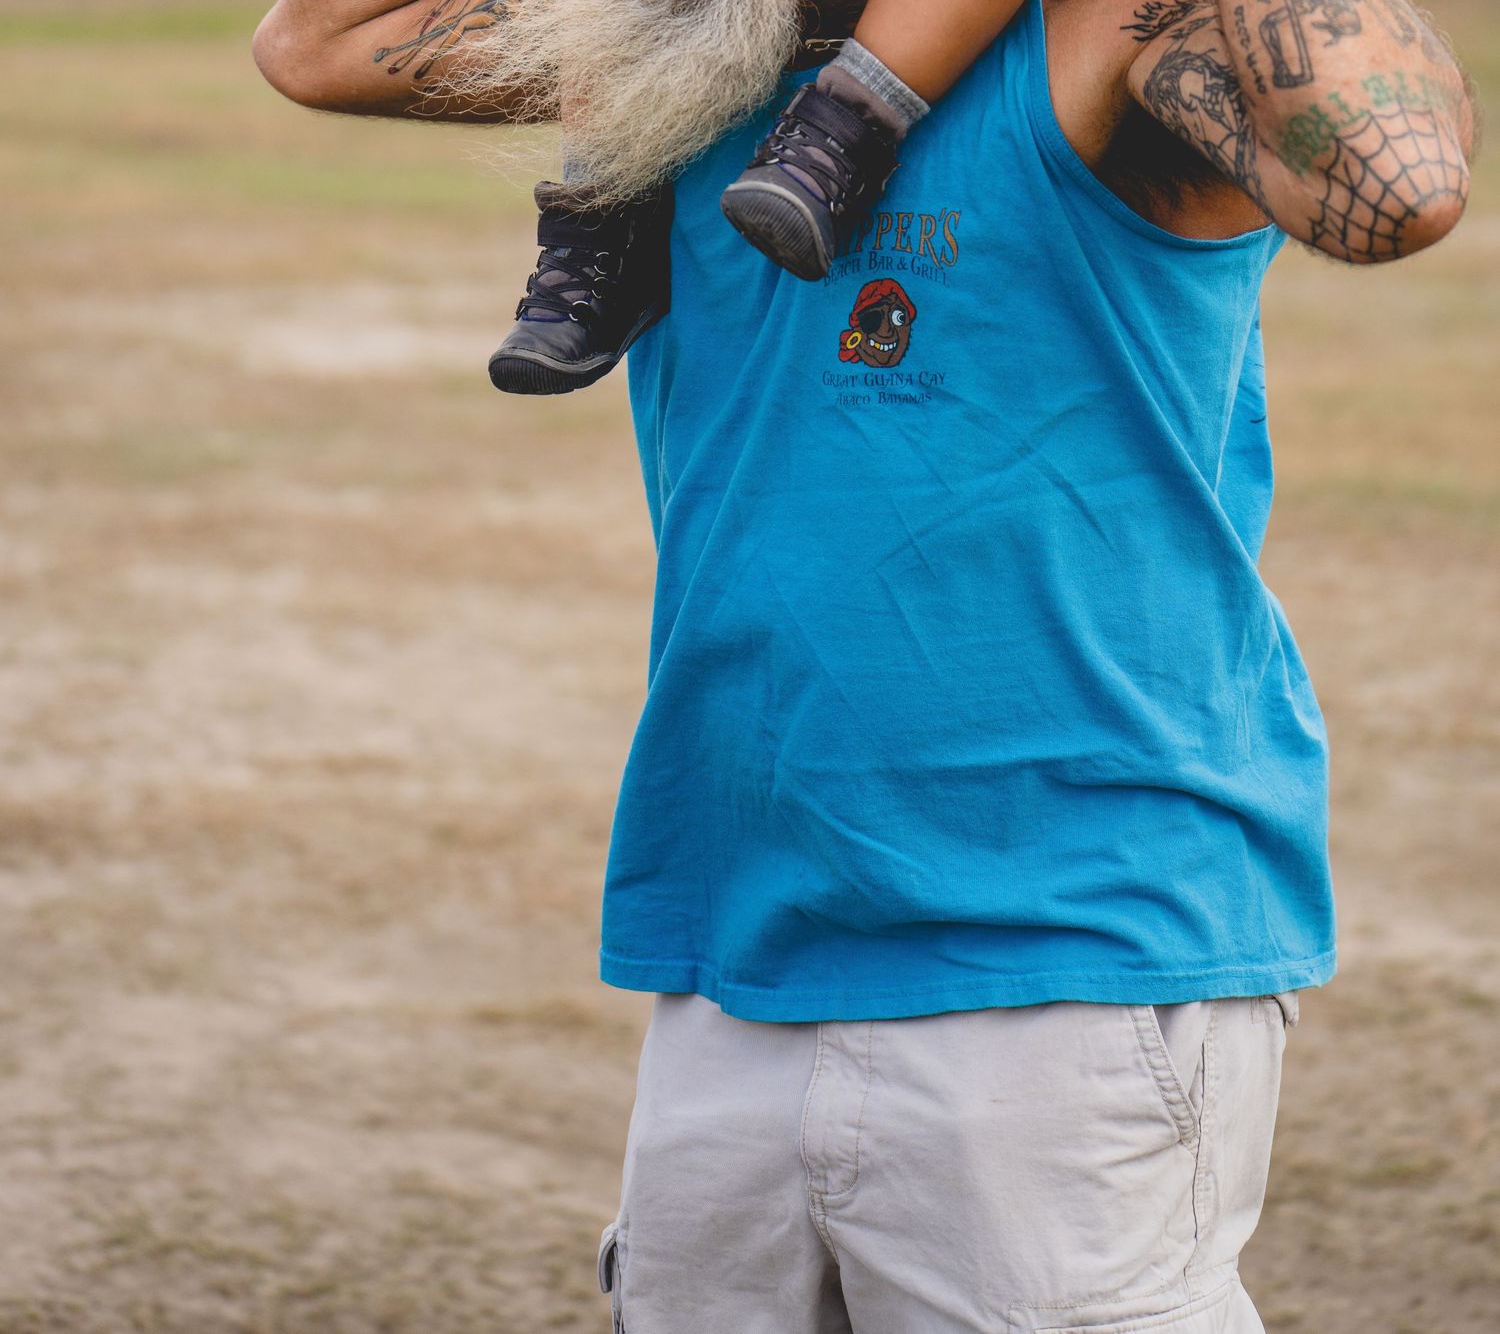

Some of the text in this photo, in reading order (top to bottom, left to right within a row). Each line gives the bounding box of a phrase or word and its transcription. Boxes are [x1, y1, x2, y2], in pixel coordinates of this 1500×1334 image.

[831, 207, 962, 267] IPPER'S
[868, 251, 893, 274] BAR
[896, 256, 908, 270] &
[917, 370, 946, 387] CAY
